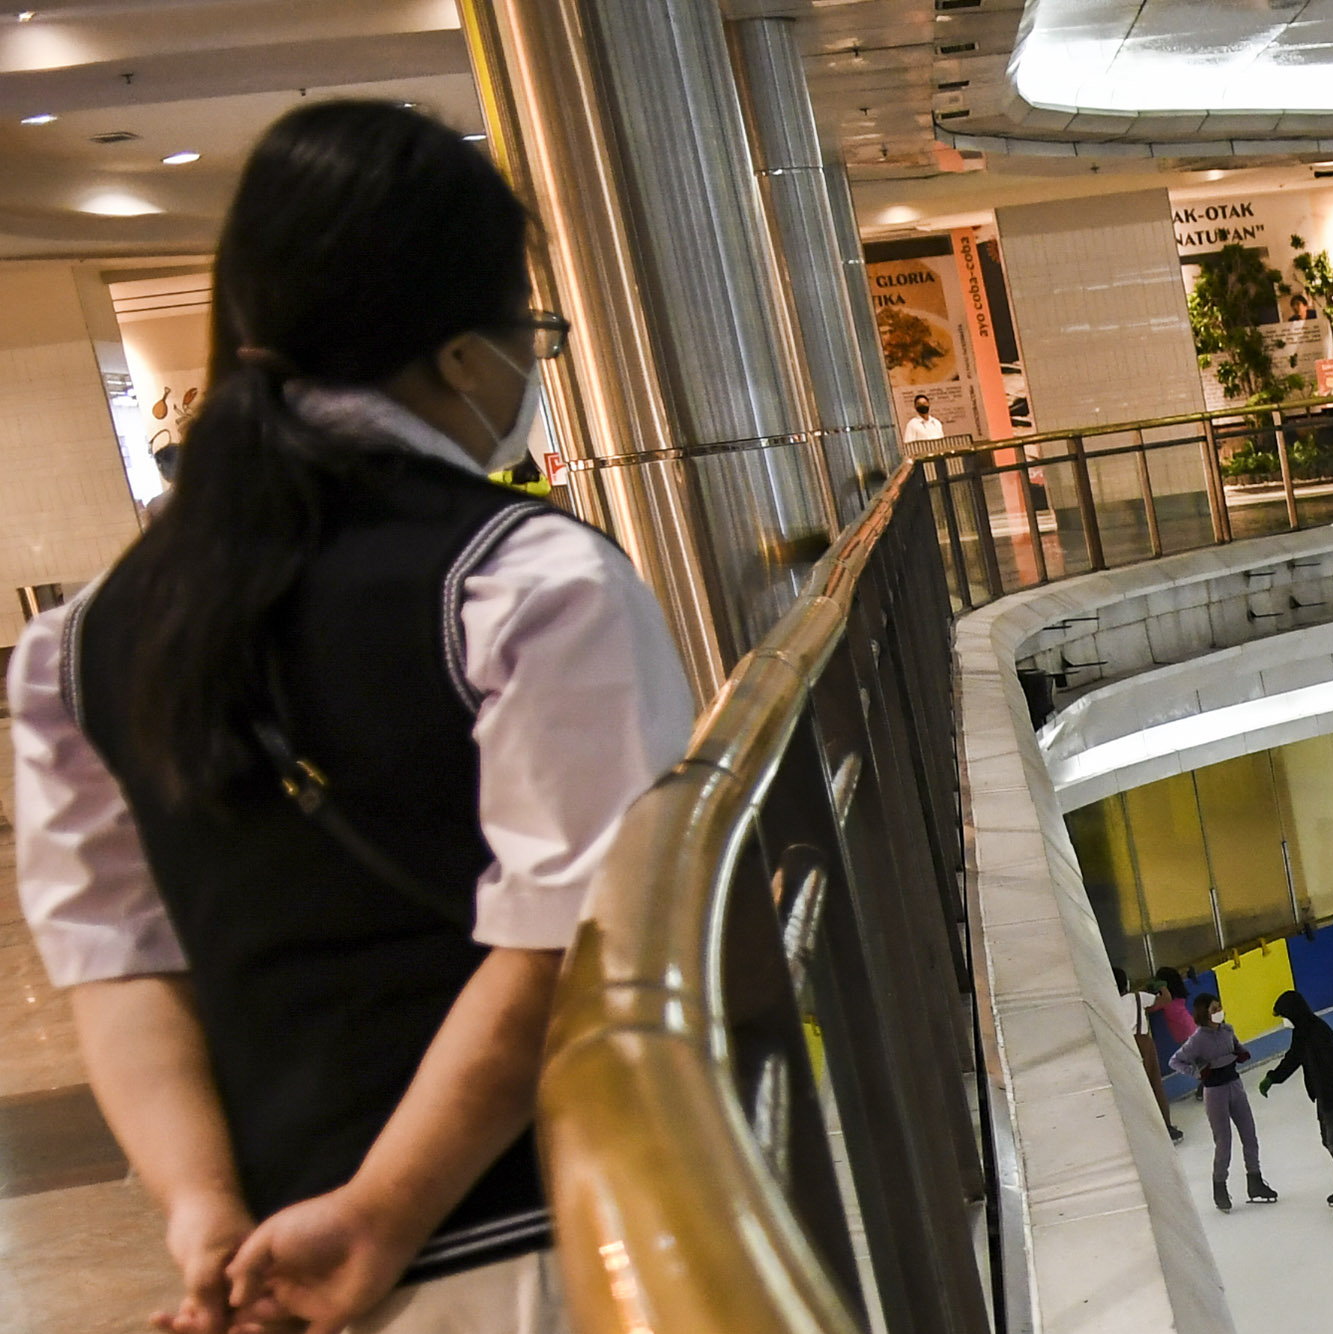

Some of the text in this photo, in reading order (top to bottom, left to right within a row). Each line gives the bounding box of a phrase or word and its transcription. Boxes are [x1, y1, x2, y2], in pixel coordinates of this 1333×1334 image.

[1173, 202, 1254, 224] AK-OTAK
[1176, 224, 1264, 246] NATUAN"
[876, 271, 935, 288] GLORIA
[961, 237, 983, 310] coba-coba
[976, 314, 988, 337] ayo
